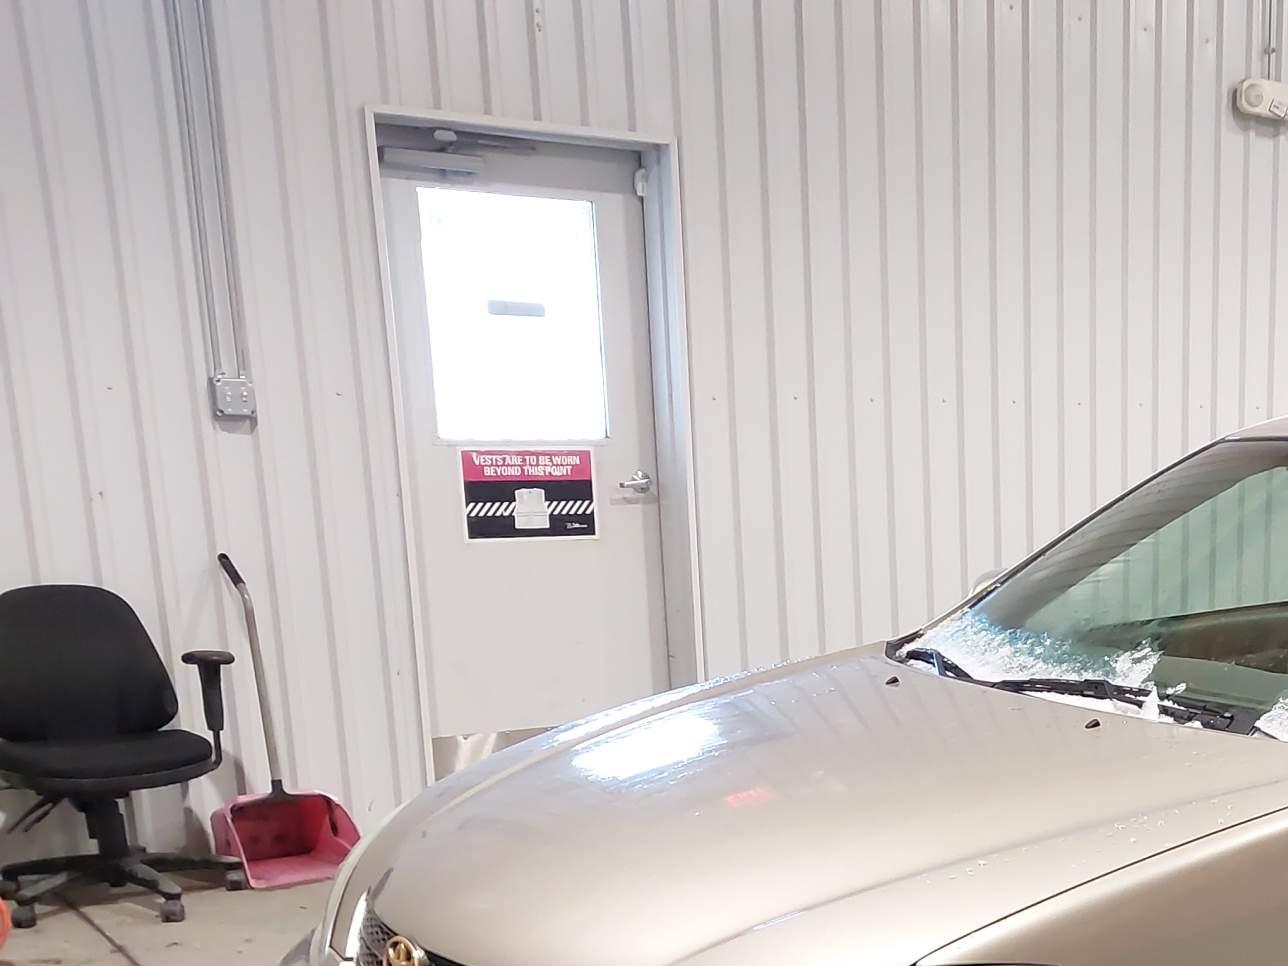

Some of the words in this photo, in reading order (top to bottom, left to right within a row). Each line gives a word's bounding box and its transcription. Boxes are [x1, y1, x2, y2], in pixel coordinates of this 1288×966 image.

[472, 454, 503, 465] VESTS
[505, 455, 523, 465] ARE
[524, 455, 537, 465] TO
[539, 455, 552, 465] BE
[552, 455, 580, 465] WORN
[484, 466, 521, 476] BEYOND
[523, 466, 544, 476] THIS
[545, 466, 572, 476] POINT
